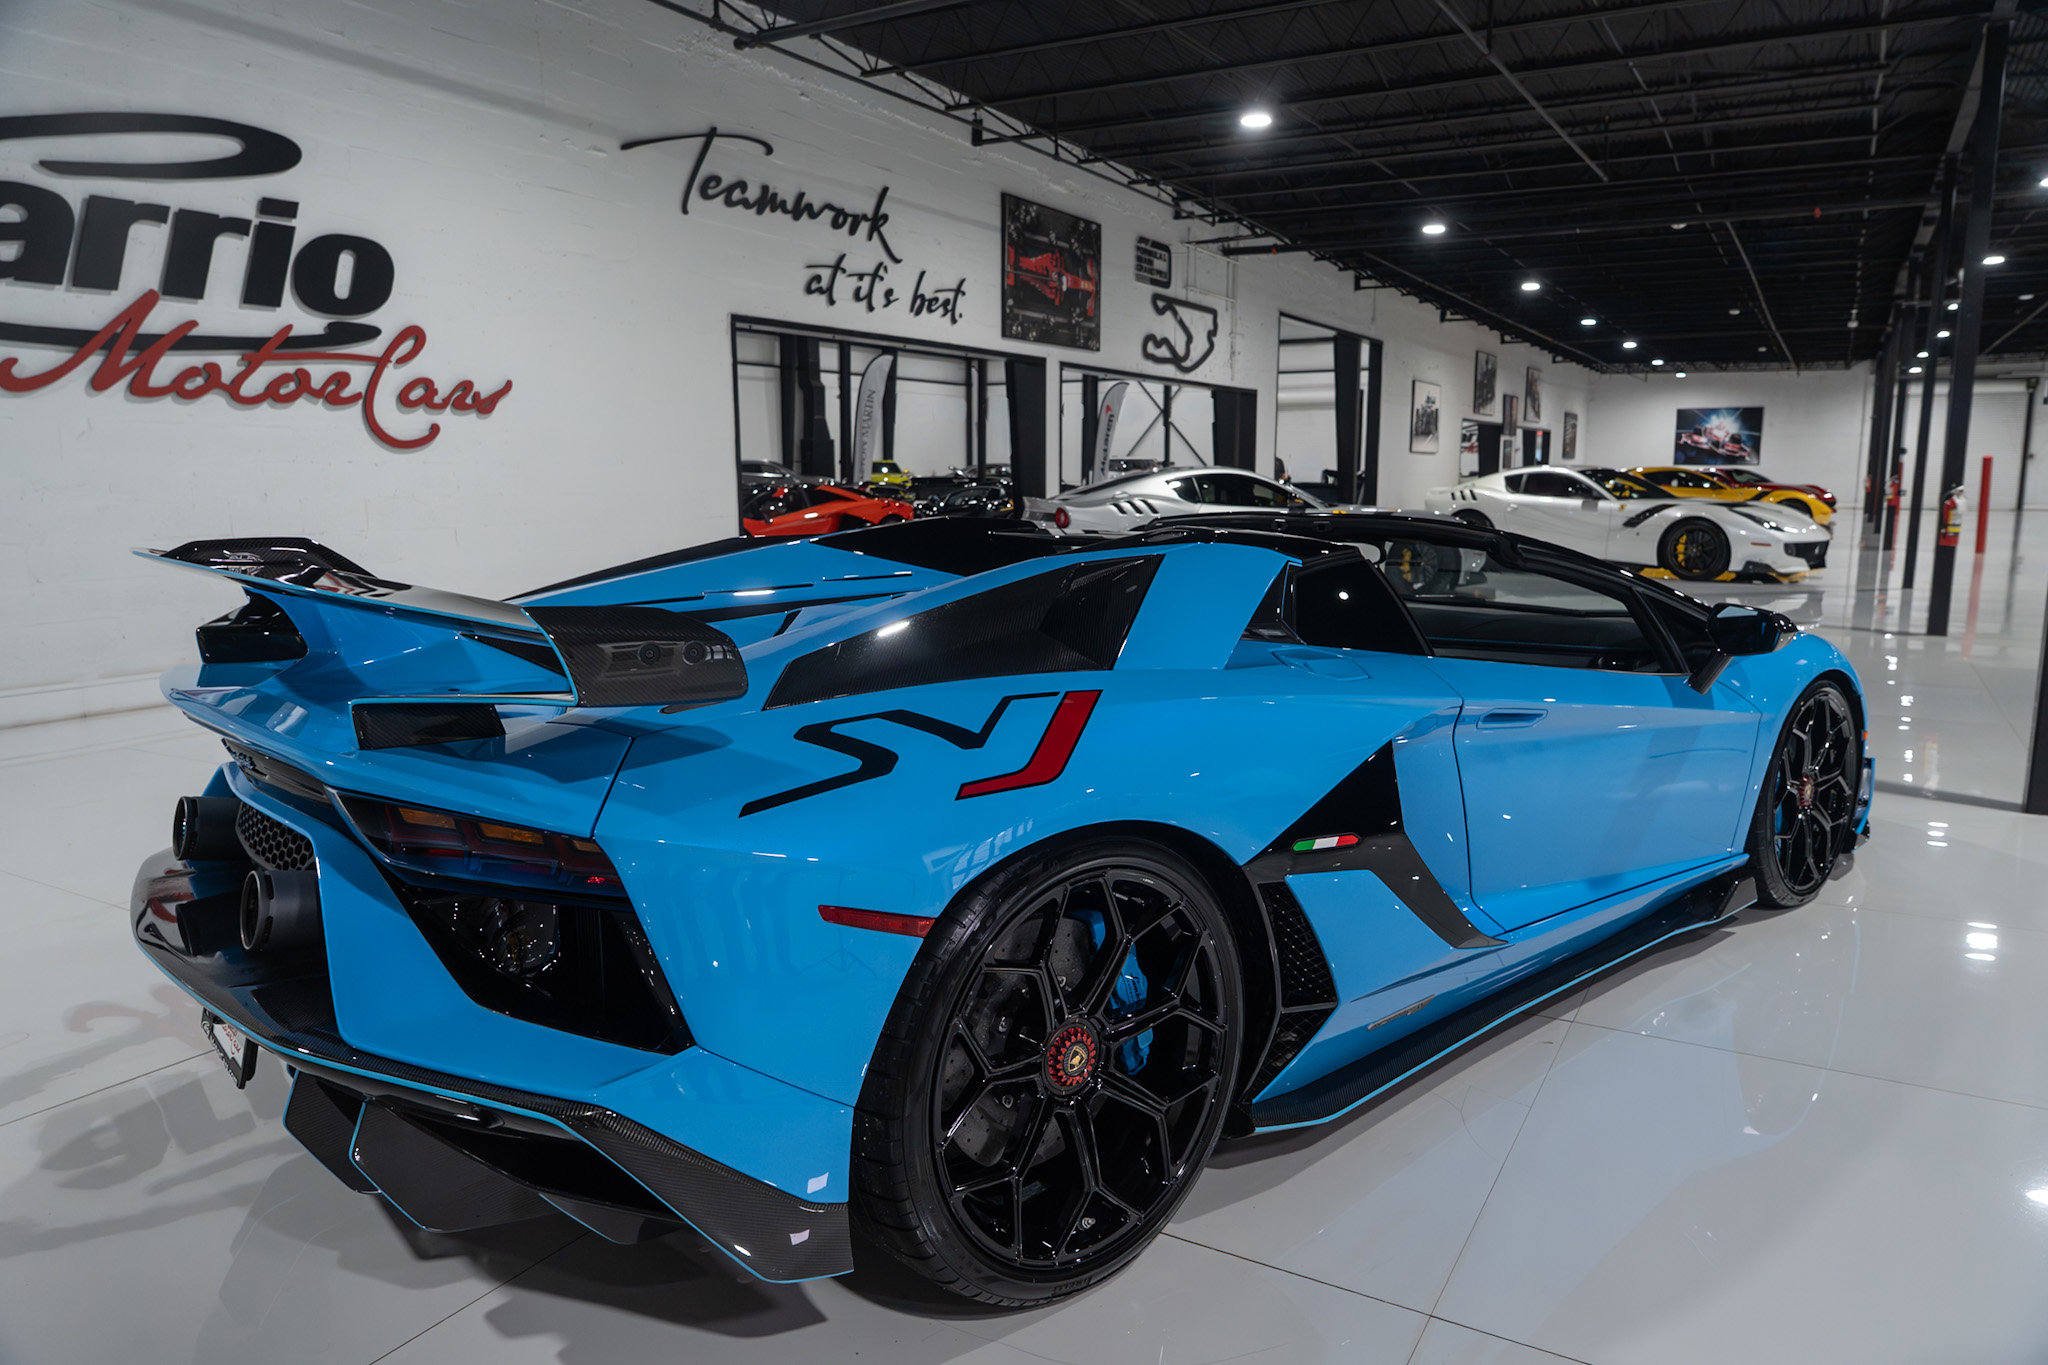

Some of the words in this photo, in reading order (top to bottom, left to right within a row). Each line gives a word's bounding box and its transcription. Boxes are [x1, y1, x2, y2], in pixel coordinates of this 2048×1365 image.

[620, 126, 903, 264] Teamwork
[0, 180, 394, 317] arrio
[805, 253, 847, 306] at
[847, 262, 900, 313] it's
[909, 270, 967, 325] best.
[862, 388, 876, 438] MARTIN
